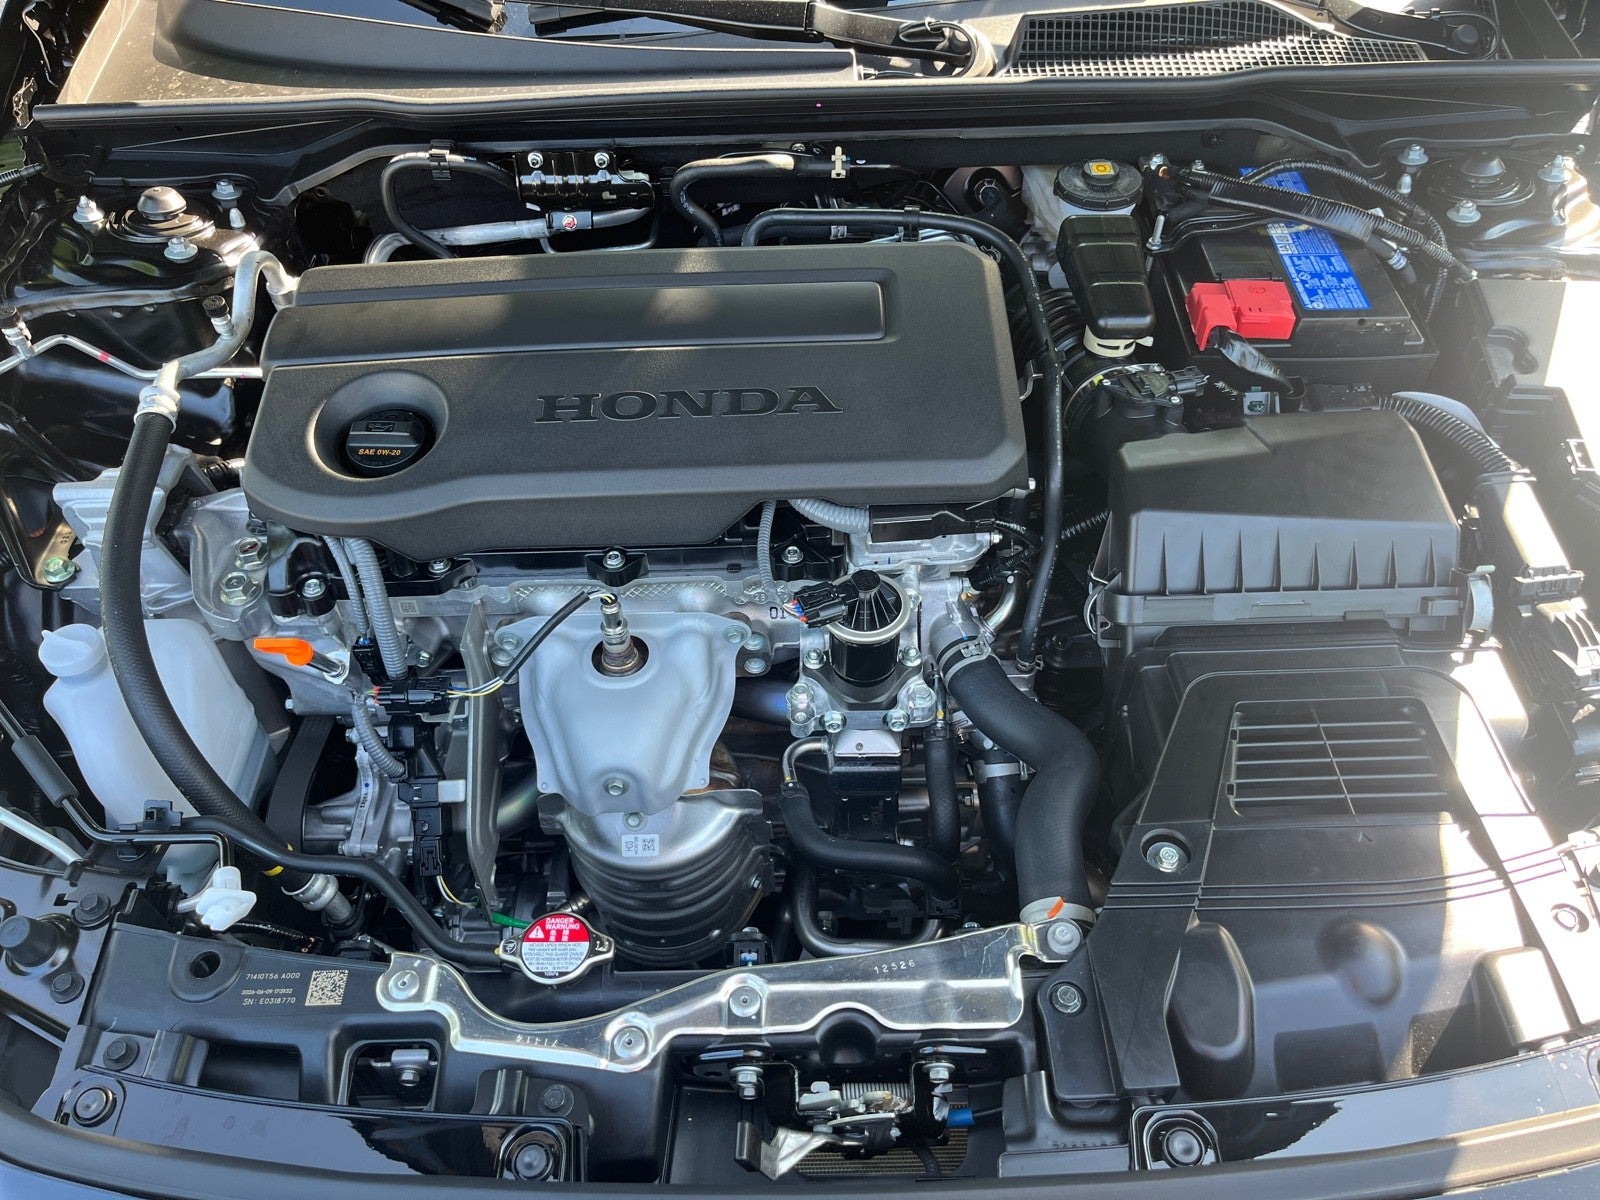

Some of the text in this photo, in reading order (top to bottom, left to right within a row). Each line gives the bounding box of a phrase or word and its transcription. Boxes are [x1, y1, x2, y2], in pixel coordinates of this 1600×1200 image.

[534, 385, 844, 424] HONDA
[376, 448, 402, 456] 0W-20
[874, 959, 916, 974] 12526
